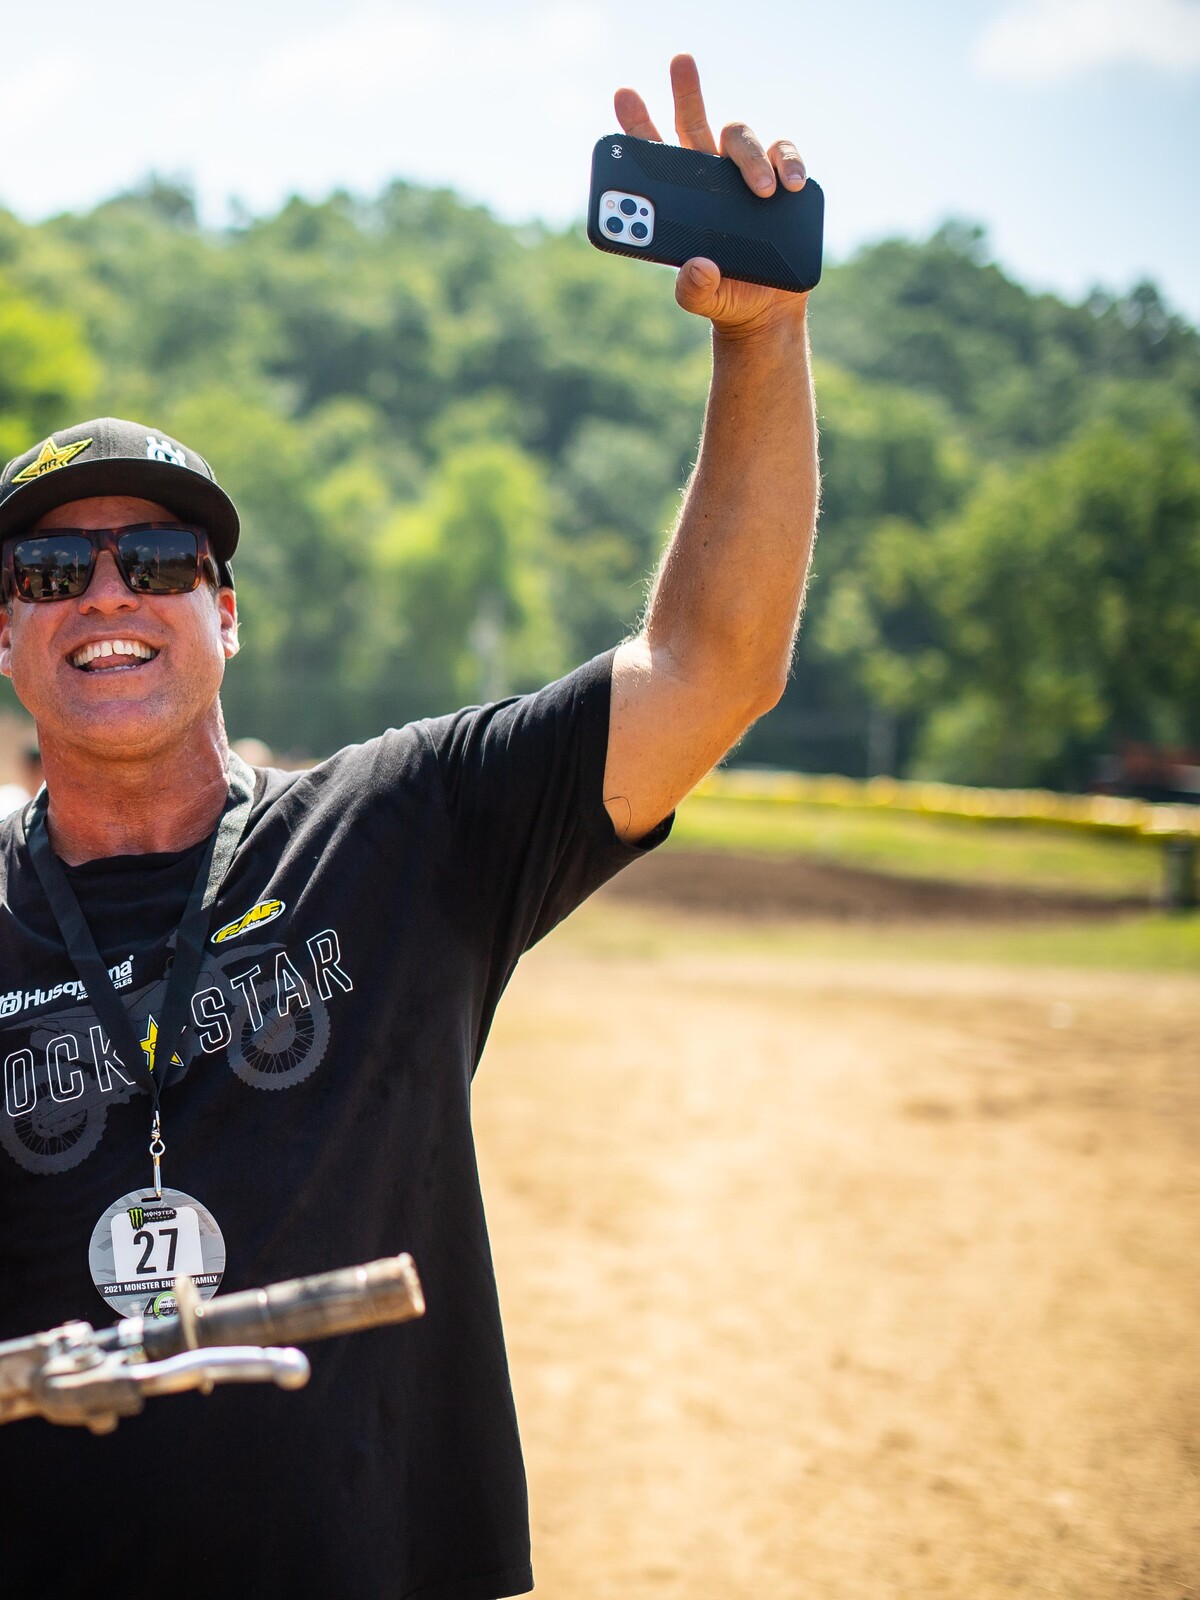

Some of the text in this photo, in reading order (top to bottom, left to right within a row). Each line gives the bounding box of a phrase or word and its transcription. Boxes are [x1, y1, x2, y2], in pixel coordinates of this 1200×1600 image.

[23, 959, 134, 1010] Husqna
[190, 928, 353, 1054] STAR
[133, 1227, 178, 1275] 27
[104, 1285, 123, 1294] 2021
[124, 1281, 160, 1292] MONSTER
[191, 1274, 218, 1285] FAMILY
